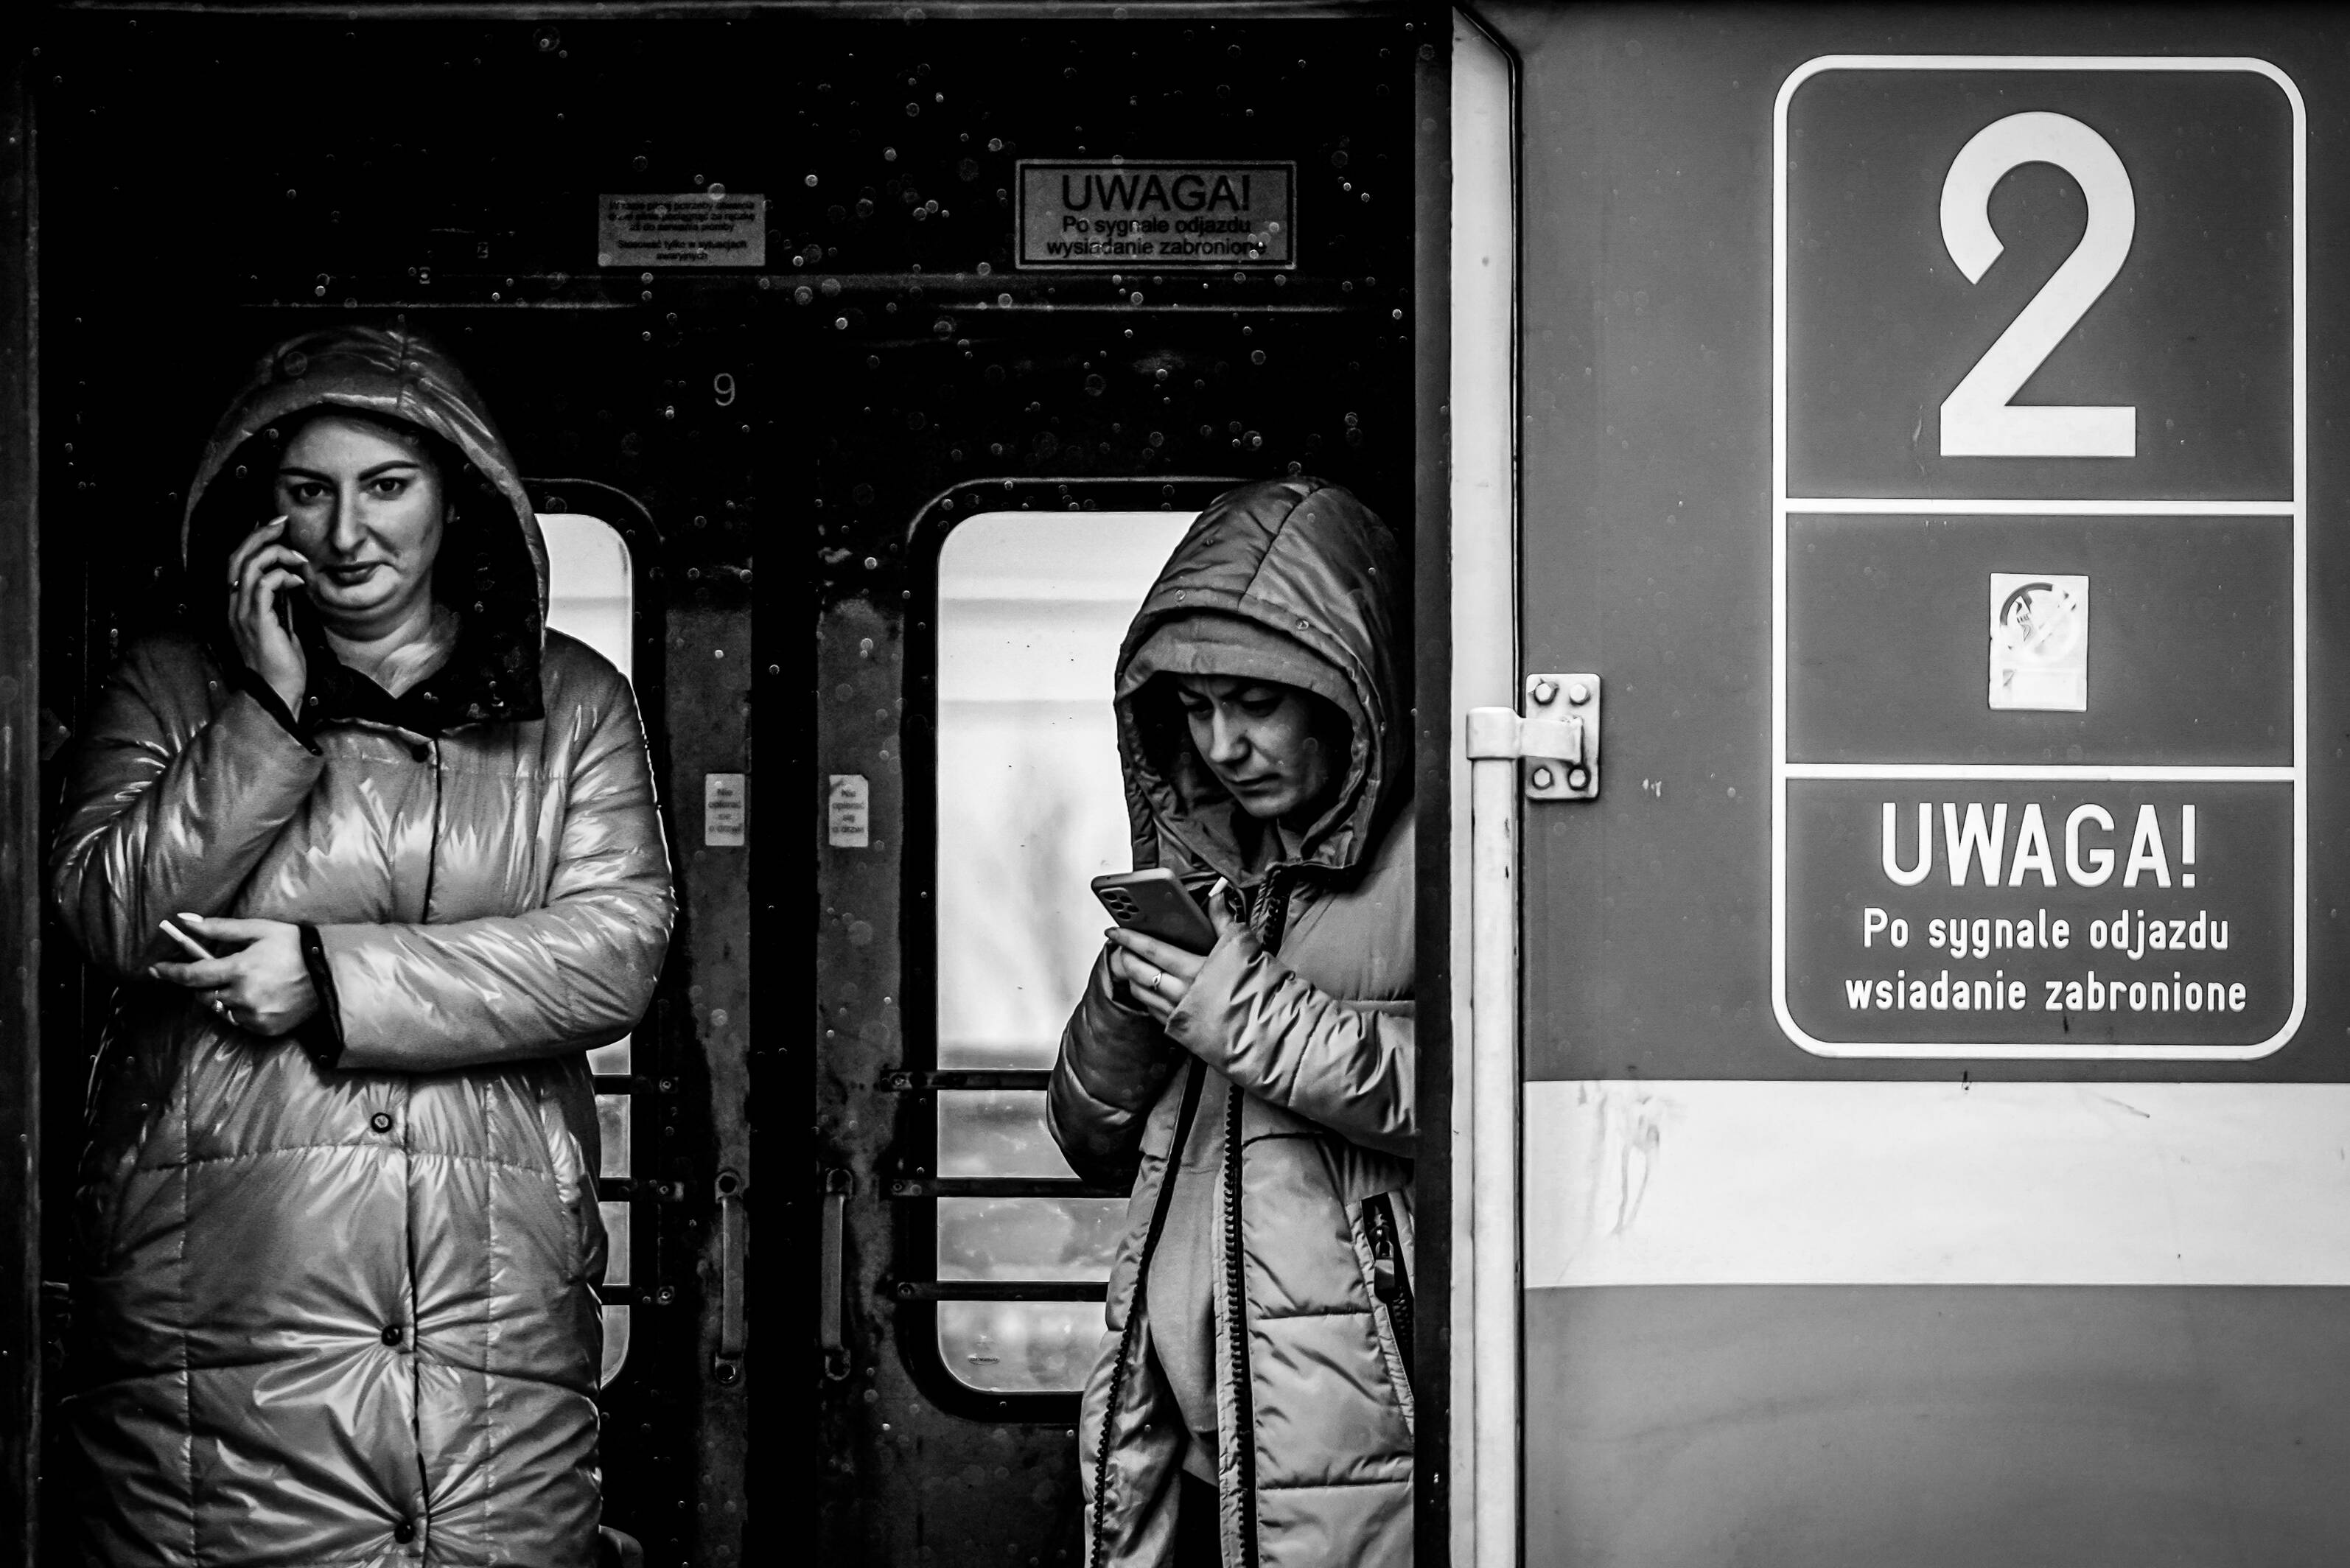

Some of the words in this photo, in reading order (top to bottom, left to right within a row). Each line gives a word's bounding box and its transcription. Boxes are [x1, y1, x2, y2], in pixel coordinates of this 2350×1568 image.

[1062, 173, 1251, 211] UWAGA!
[1063, 216, 1089, 233] Po
[1095, 216, 1170, 237] sygnale
[1177, 216, 1251, 237] odjazdu
[1046, 238, 1153, 259] wysiadanie
[1160, 238, 1267, 256] zabronione
[1939, 110, 2136, 458] 2
[713, 373, 735, 406] 9
[1881, 802, 2196, 889] UWAGA!
[1863, 907, 1910, 948] Po
[1928, 908, 2071, 959] sygnale
[2089, 909, 2230, 960] odjazdu
[1845, 969, 2027, 1011] wsiadanie
[2045, 970, 2247, 1012] zabronione
